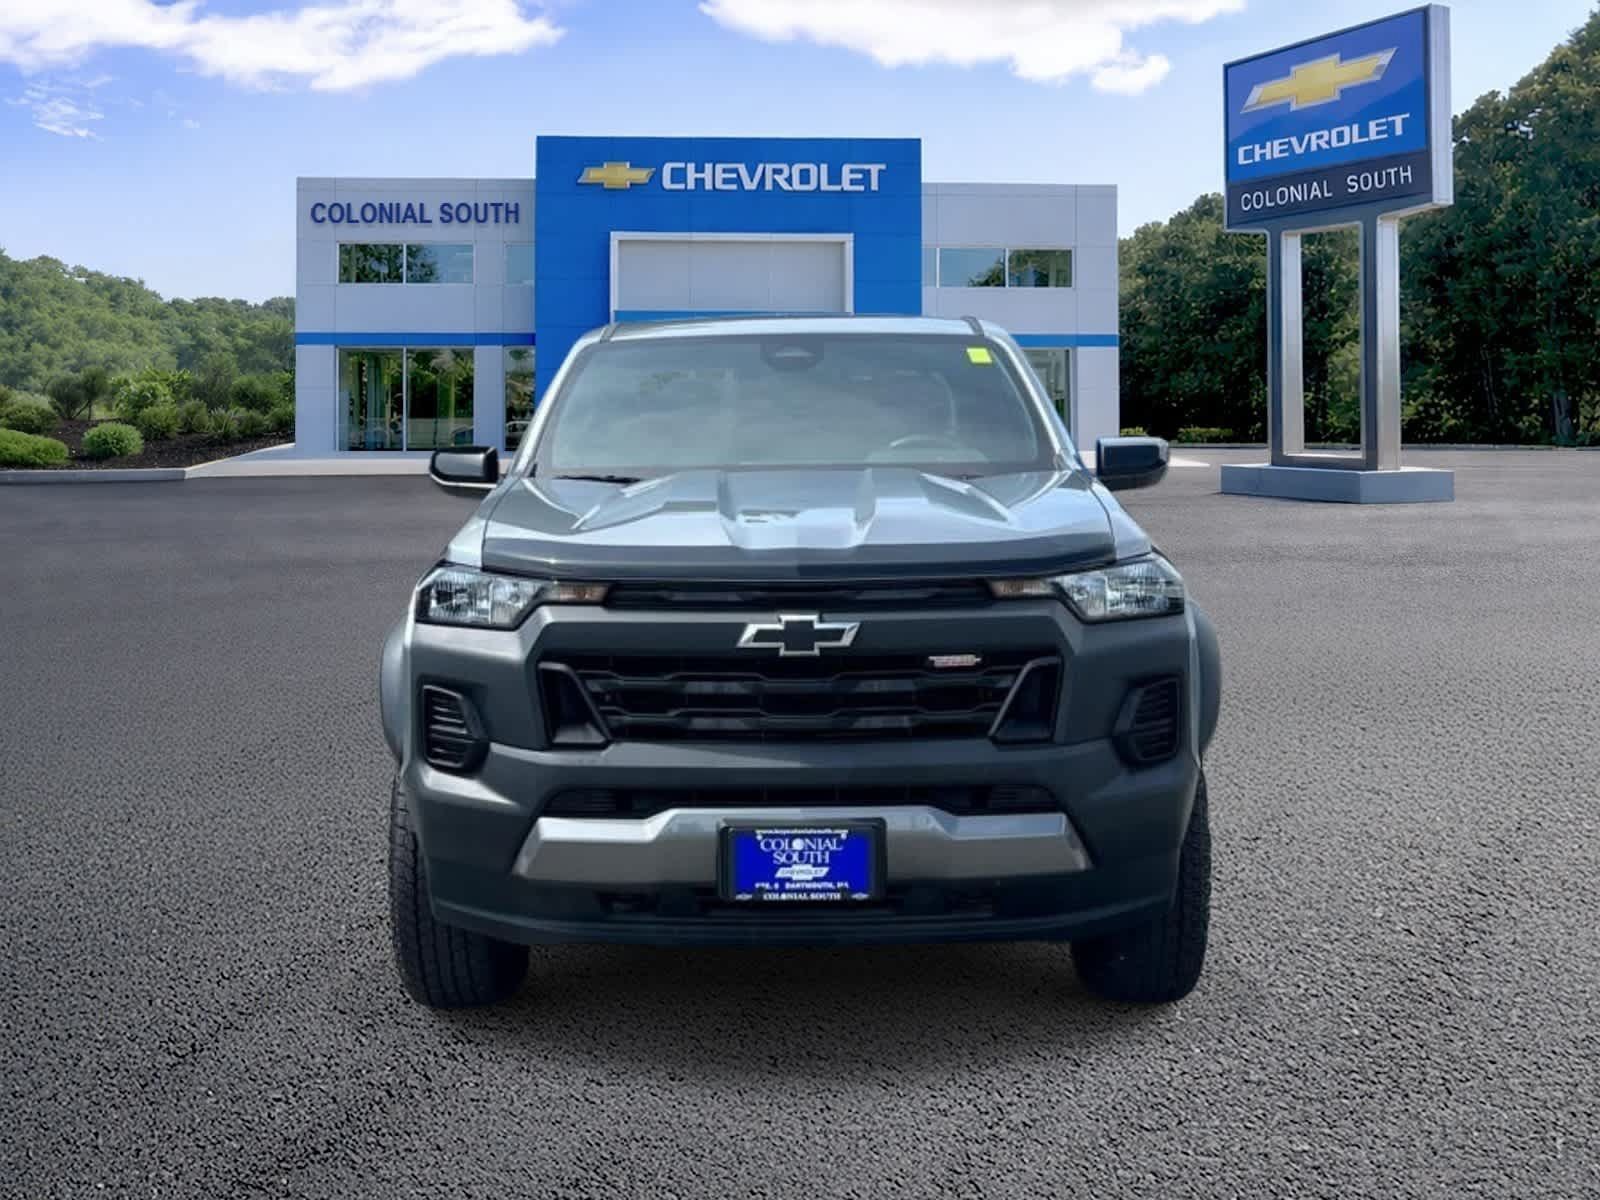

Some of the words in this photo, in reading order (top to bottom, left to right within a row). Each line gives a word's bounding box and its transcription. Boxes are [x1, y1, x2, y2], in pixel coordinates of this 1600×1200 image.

[1237, 112, 1411, 166] CHEVROLET
[661, 161, 887, 192] CHEVROLET
[1240, 181, 1333, 211] COLONIAL
[1346, 165, 1413, 193] SOUTH
[310, 202, 433, 225] COLONIAL
[439, 202, 520, 224] SOUTH
[760, 838, 843, 852] COLONIAL
[773, 851, 830, 864] SOUTH
[763, 892, 809, 901] COLONIAL
[810, 892, 842, 901] SOUTH
